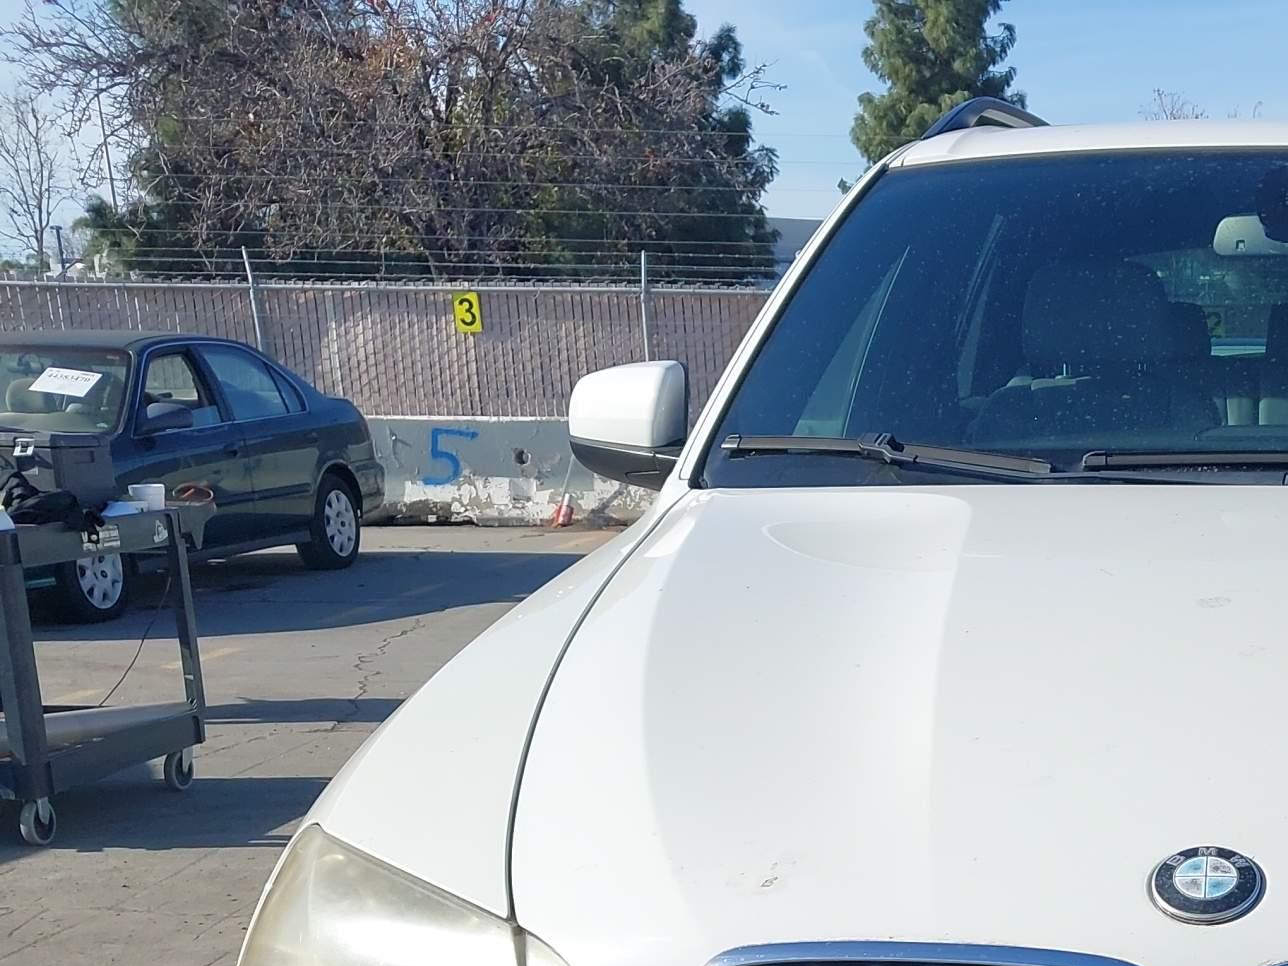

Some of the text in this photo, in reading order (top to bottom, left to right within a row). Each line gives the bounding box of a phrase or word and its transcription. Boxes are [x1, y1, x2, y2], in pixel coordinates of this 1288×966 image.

[458, 298, 477, 326] 3
[423, 428, 480, 485] 5
[1166, 847, 1250, 868] BMW
